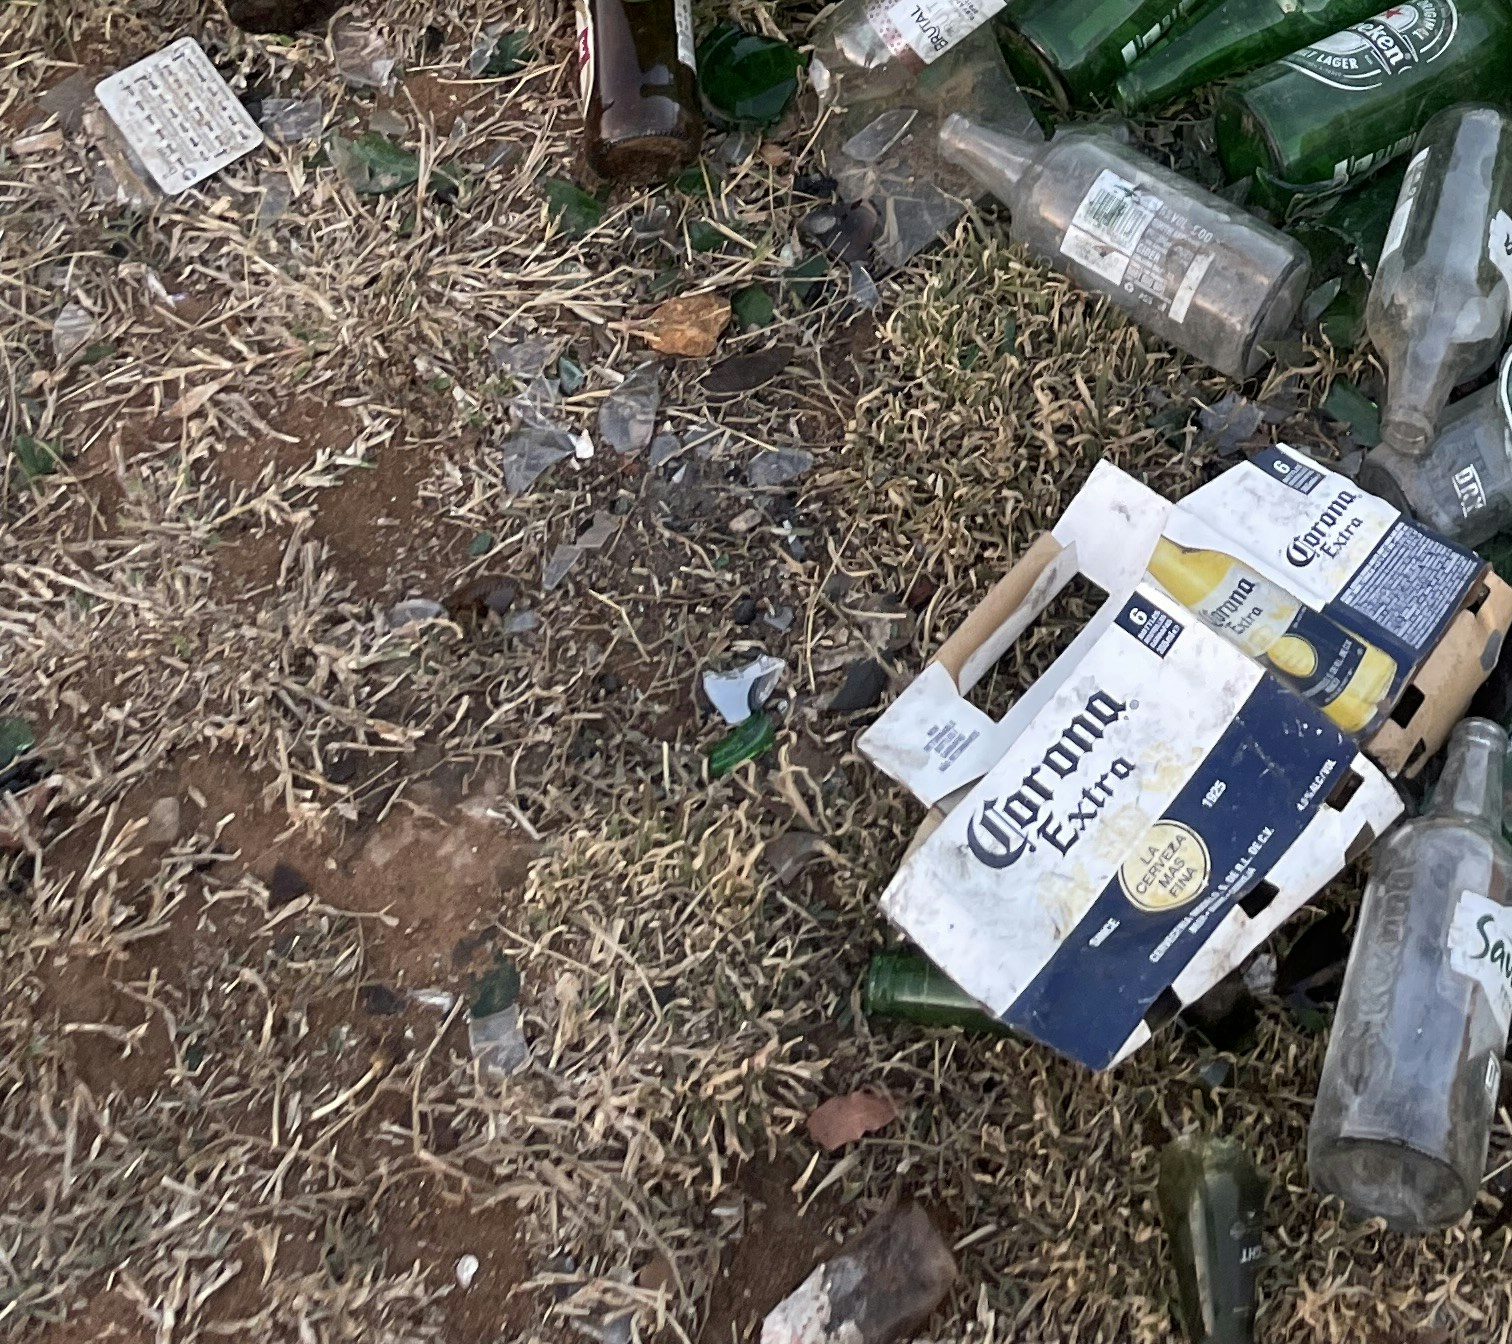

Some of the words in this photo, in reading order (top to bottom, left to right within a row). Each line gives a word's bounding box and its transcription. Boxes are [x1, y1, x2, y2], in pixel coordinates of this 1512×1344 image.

[911, 3, 950, 58] BRUTAL
[1357, 19, 1408, 65] eken
[1316, 51, 1359, 71] LAGER
[1273, 460, 1292, 476] 6
[1285, 487, 1359, 568] Corona
[1321, 514, 1367, 562] Extra
[1129, 607, 1148, 626] 6
[1230, 603, 1262, 637] Extra
[965, 687, 1130, 871] Corona
[1200, 779, 1229, 809] 1925
[1040, 755, 1138, 857] Extra
[1133, 834, 1187, 895] CERVEZA
[1138, 844, 1160, 865] LA
[1169, 877, 1198, 905] FINA
